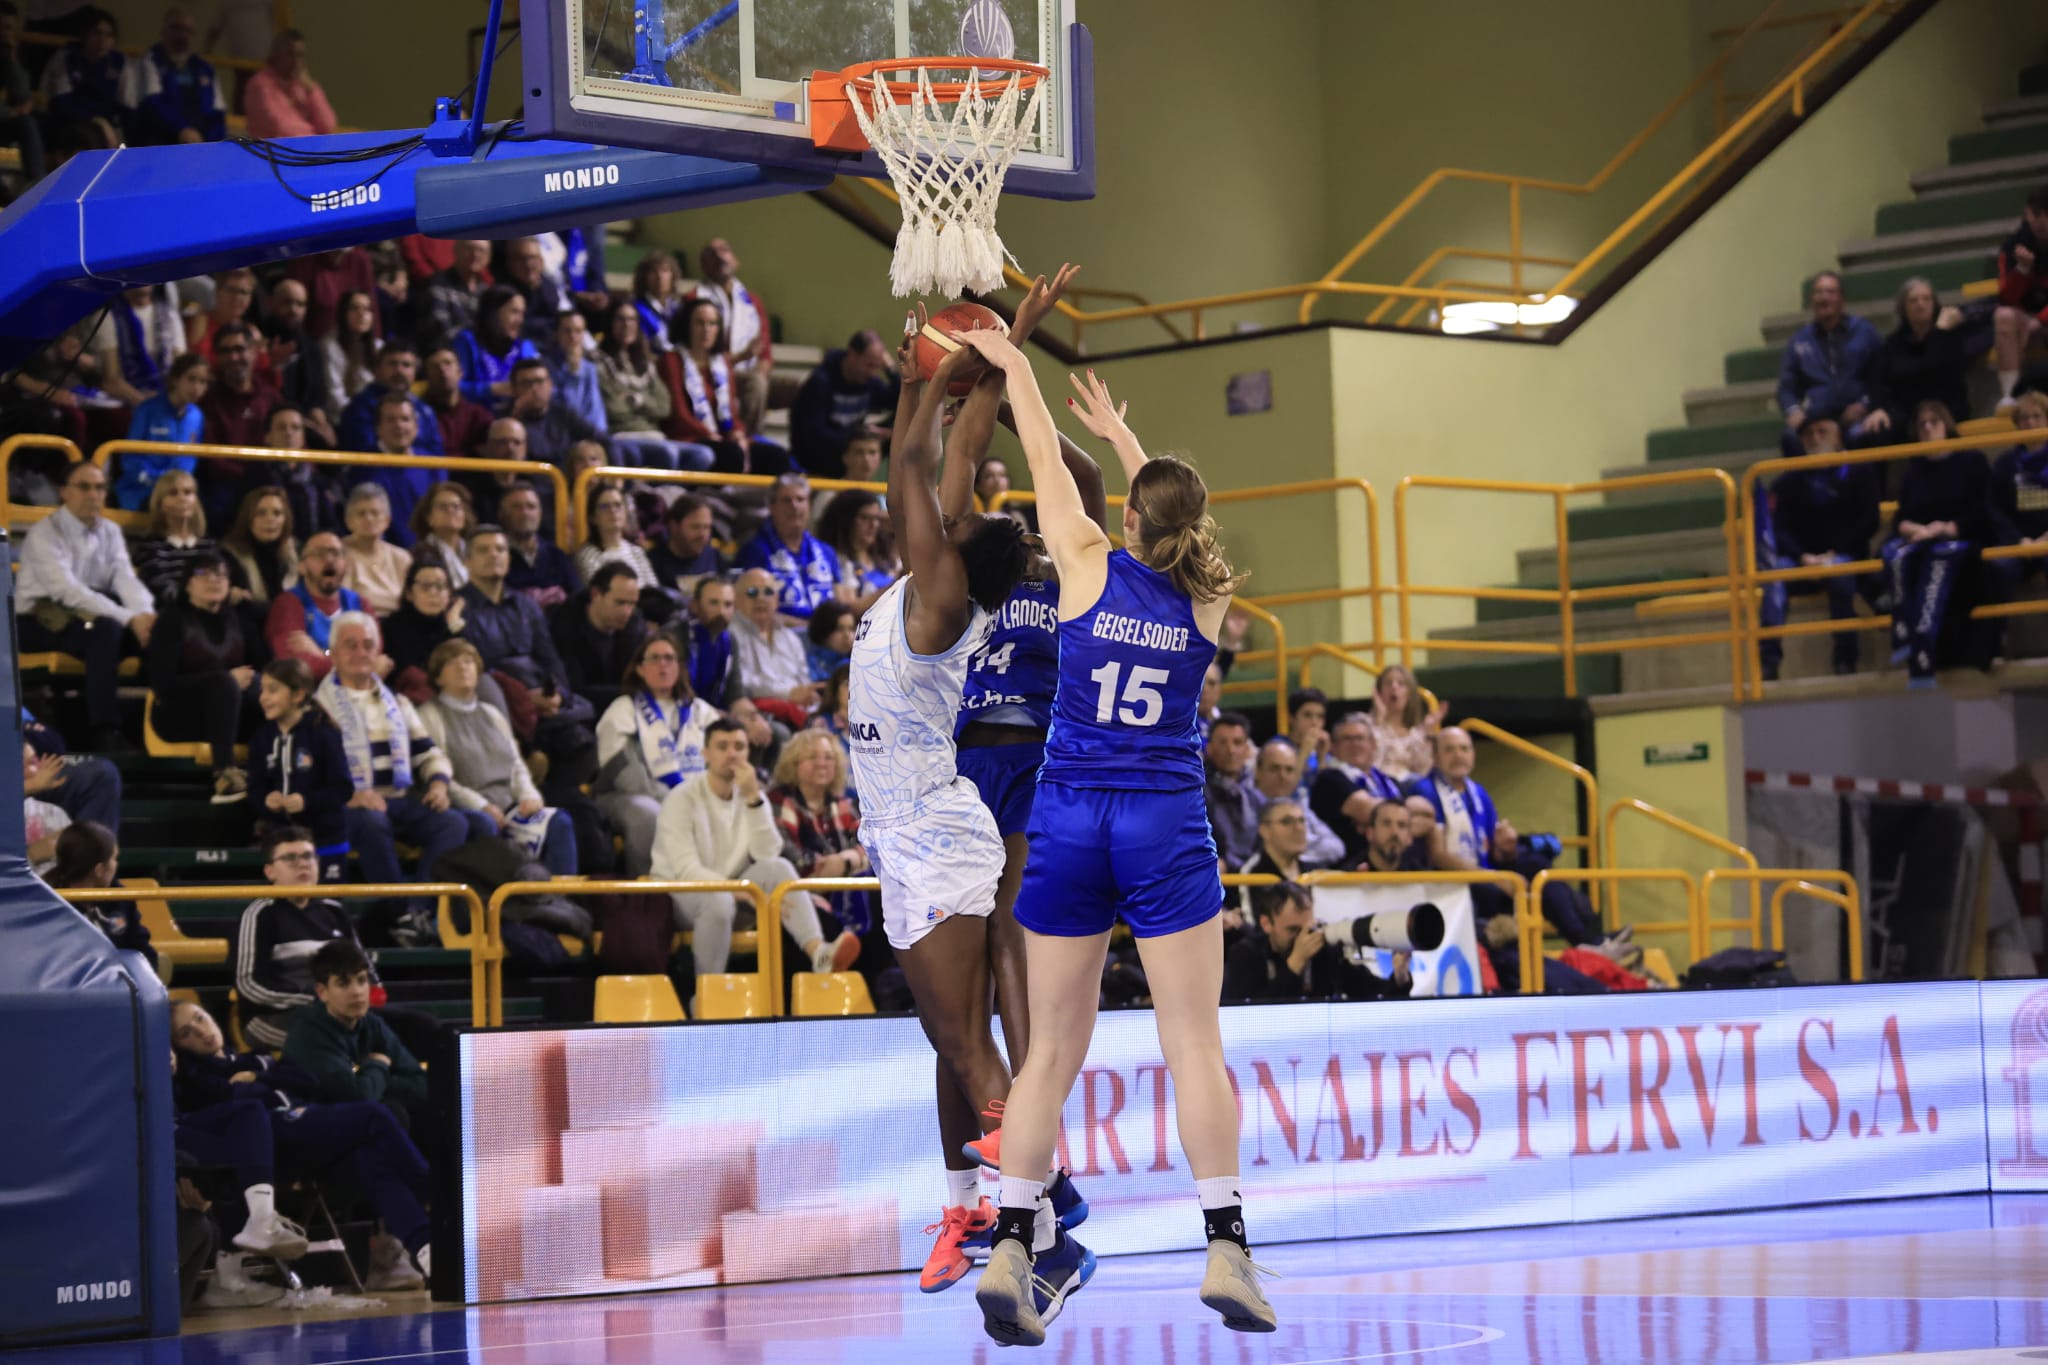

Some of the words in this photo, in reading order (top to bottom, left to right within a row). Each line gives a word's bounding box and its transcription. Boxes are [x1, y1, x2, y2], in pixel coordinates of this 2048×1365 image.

[544, 164, 619, 193] MONDO
[311, 183, 381, 213] MONDO
[1003, 599, 1058, 634] LANDES
[1092, 611, 1190, 652] GEISELSODER
[972, 642, 1016, 675] 14
[1091, 661, 1170, 727] 15
[981, 1047, 1482, 1181] RTNAJES
[1511, 1023, 1766, 1160] FERVI
[1796, 1014, 1939, 1142] S.A.
[57, 1280, 131, 1305] MONDO
